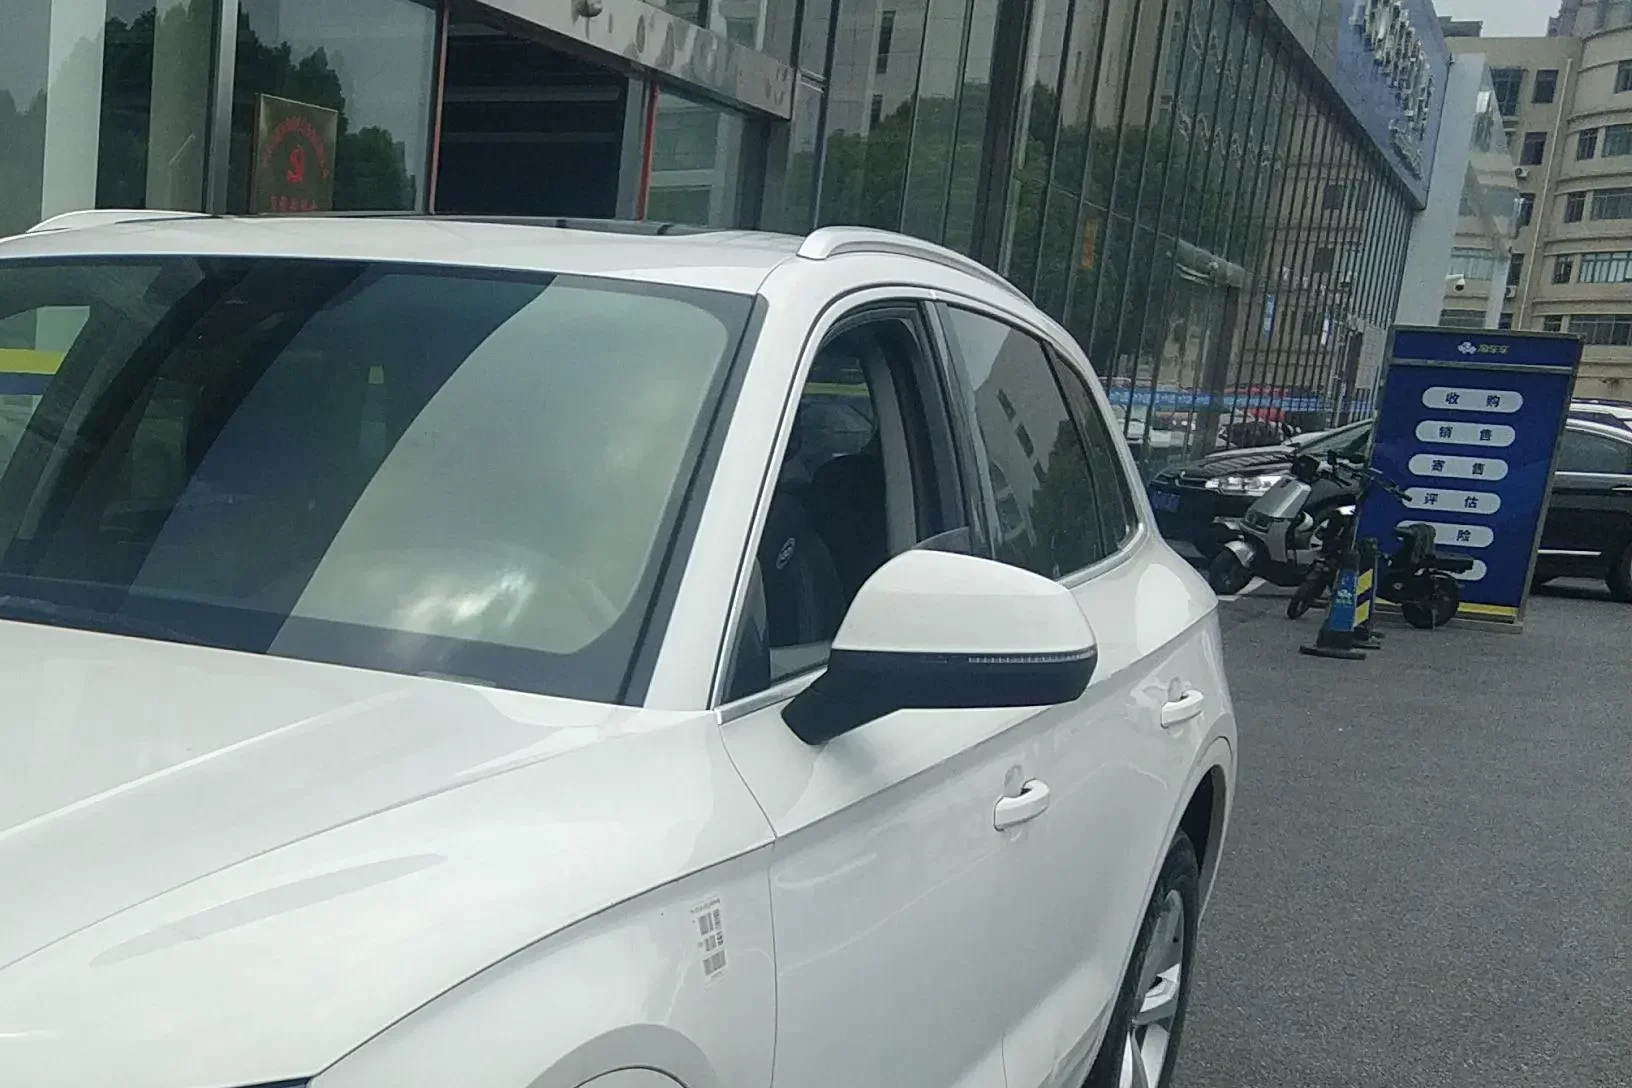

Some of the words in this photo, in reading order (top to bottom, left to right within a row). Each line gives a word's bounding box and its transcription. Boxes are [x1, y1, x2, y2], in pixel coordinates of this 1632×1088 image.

[1445, 391, 1501, 408] 收购
[1439, 426, 1493, 441] 销售
[1431, 459, 1485, 475] 寄售
[1423, 492, 1479, 509] 评估
